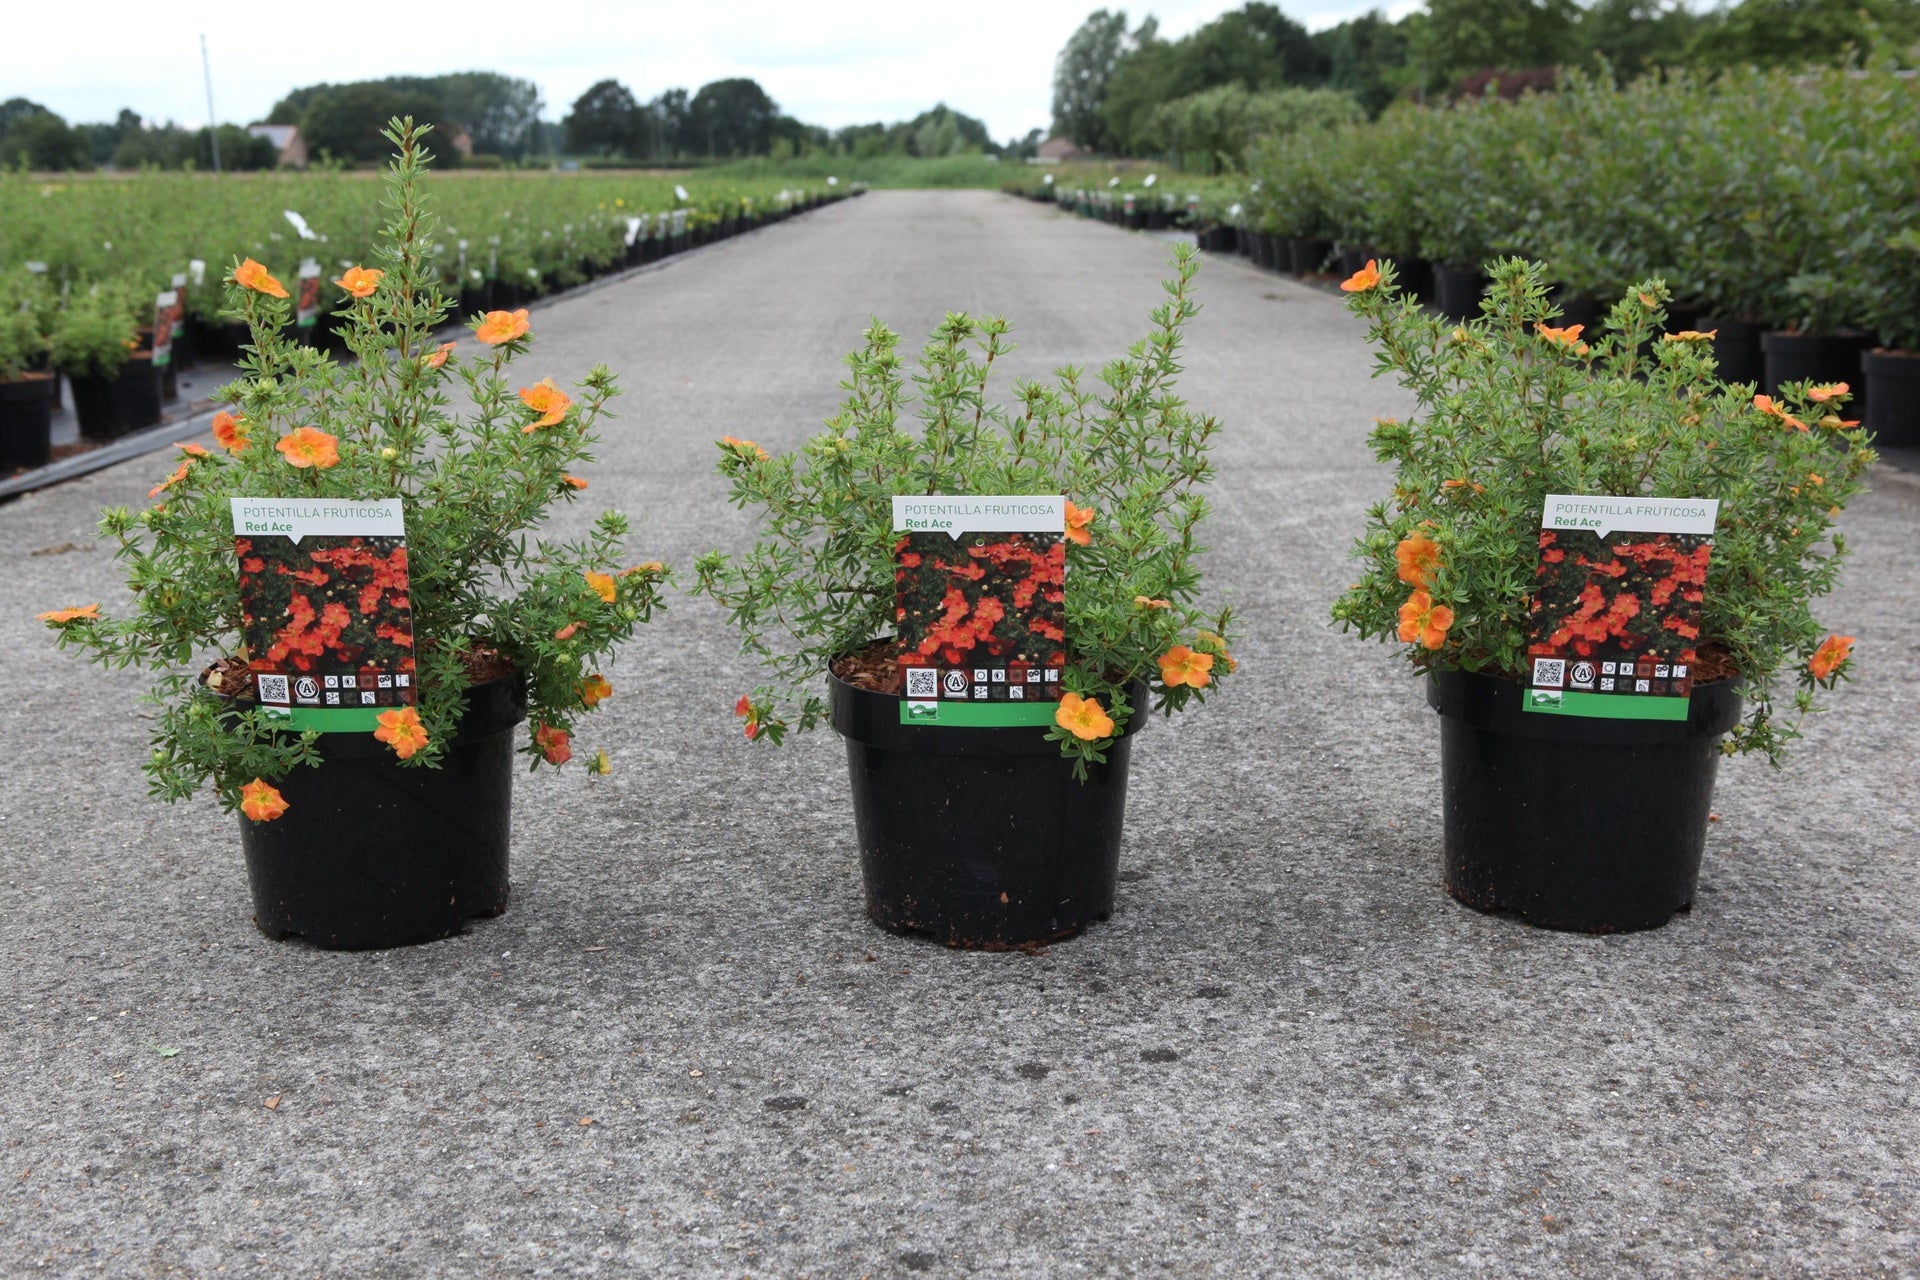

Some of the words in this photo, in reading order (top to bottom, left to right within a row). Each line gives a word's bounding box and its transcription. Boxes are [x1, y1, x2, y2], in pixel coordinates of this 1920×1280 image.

[244, 508, 320, 518] POTENTILLA
[323, 508, 392, 518] FRUTICOSA
[905, 505, 981, 515] POTENTILLA
[985, 505, 1054, 515] FRUTICOSA
[1556, 504, 1633, 515] POTENTILLA
[1636, 506, 1706, 518] FRUTICOSA
[905, 518, 928, 528] Red
[931, 518, 953, 528] Ace
[1554, 516, 1577, 526] Red
[1580, 517, 1602, 527] Ace
[245, 522, 268, 532] Red
[271, 523, 293, 532] Ace
